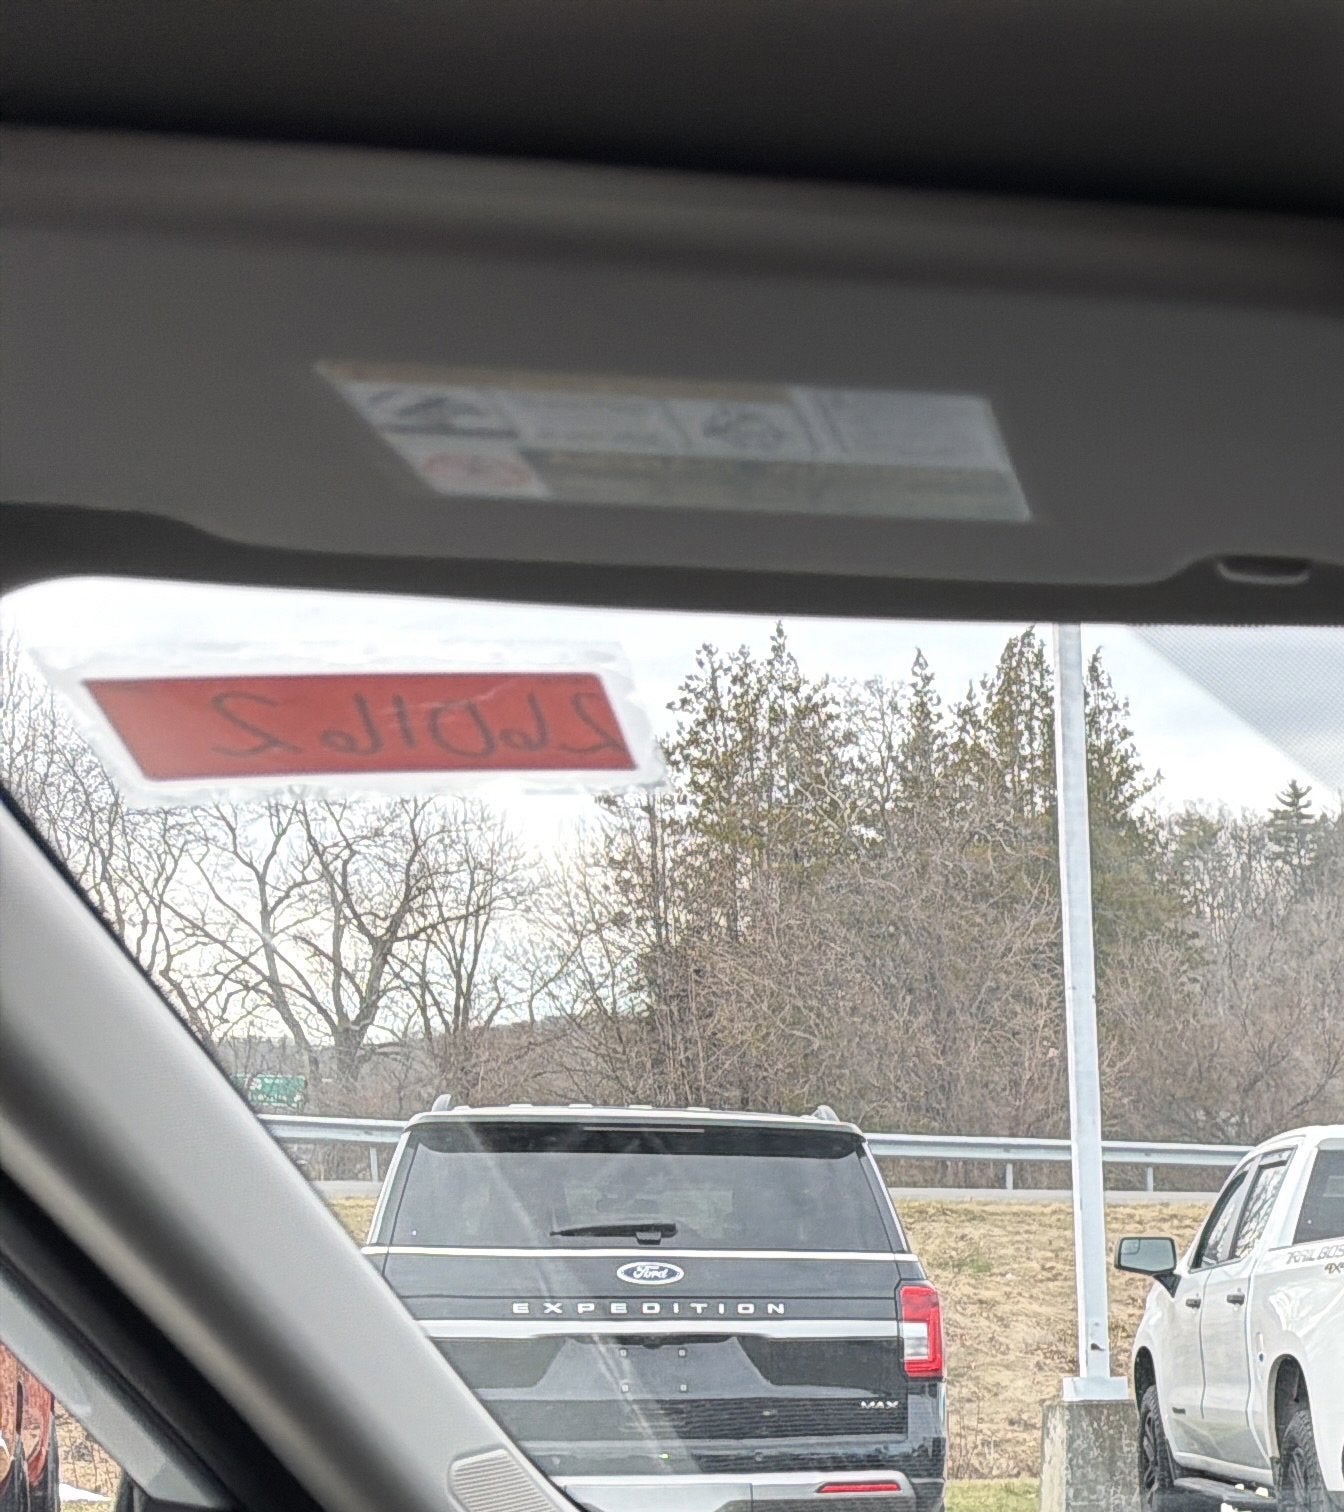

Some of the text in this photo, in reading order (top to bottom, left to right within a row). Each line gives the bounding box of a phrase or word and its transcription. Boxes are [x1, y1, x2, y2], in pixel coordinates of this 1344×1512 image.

[632, 1264, 669, 1281] Ford
[512, 1302, 785, 1315] EXPEDITION
[860, 1400, 899, 1411] MAX
